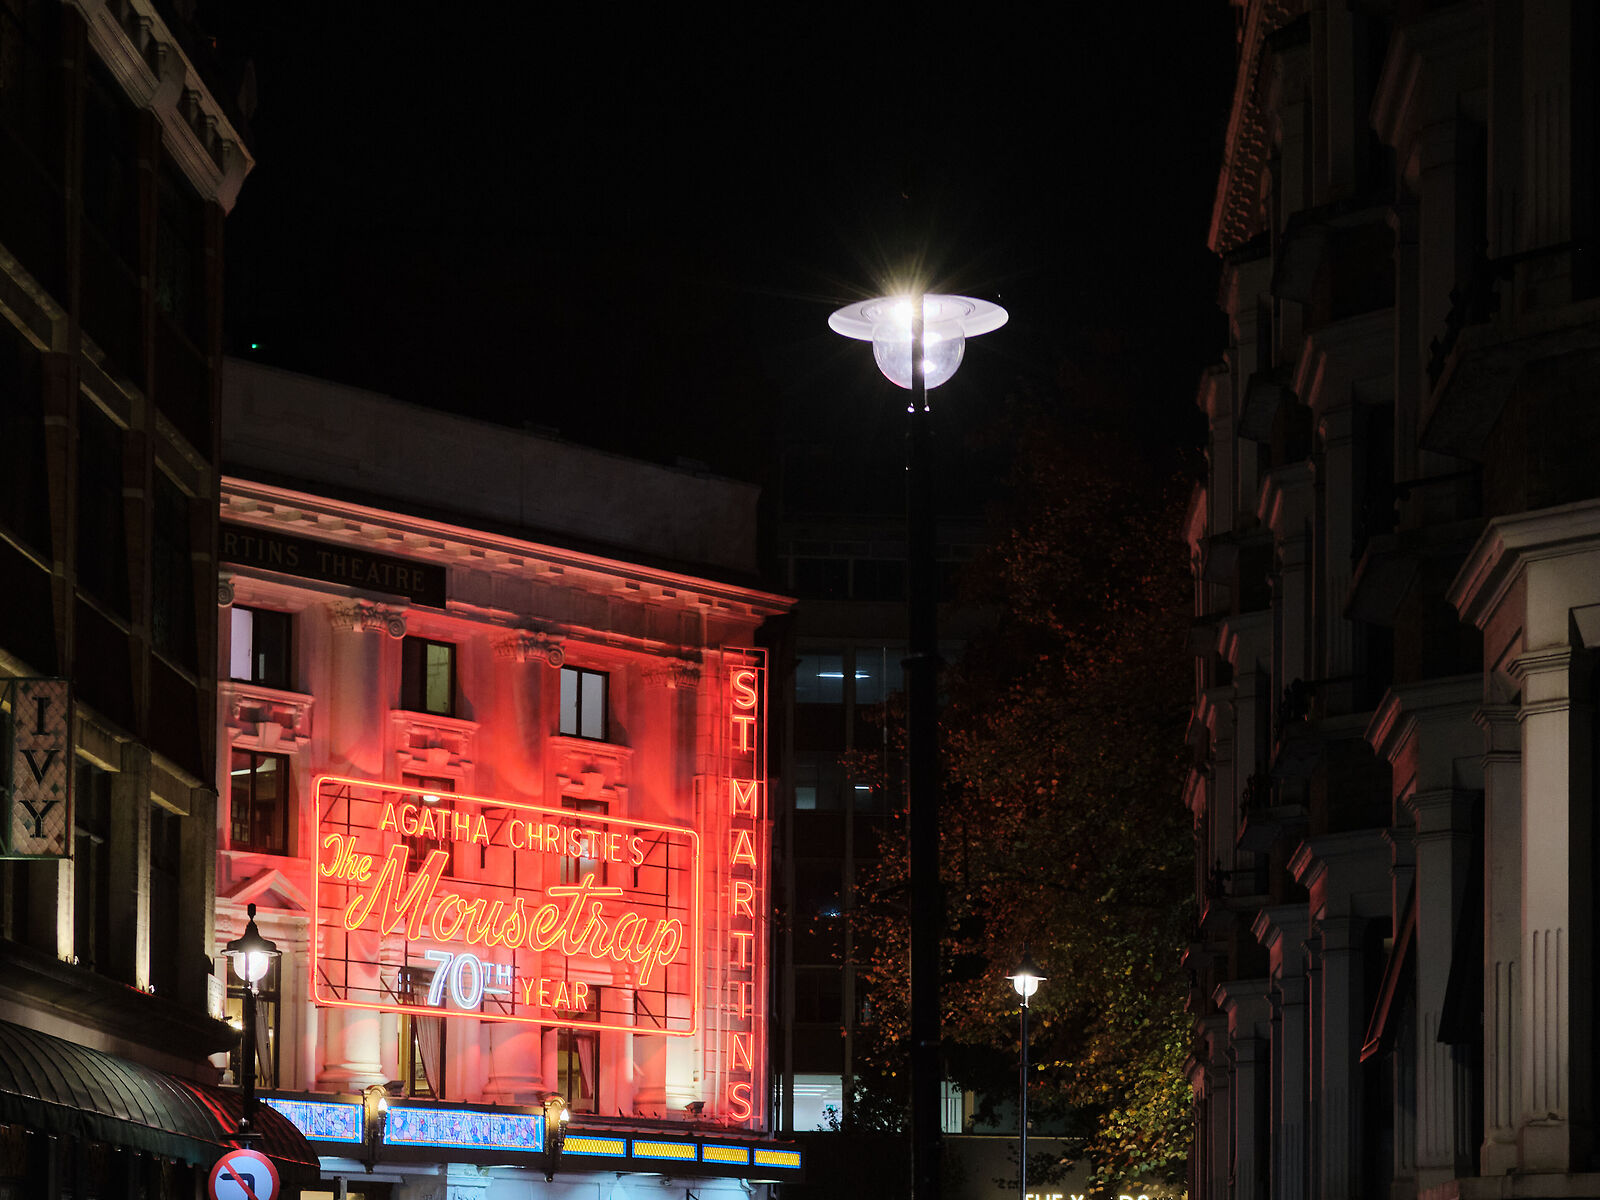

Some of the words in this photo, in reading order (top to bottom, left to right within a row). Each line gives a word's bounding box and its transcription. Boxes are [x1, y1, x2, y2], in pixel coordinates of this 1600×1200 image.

[223, 531, 299, 567] RTINS
[317, 551, 425, 592] THEATRE
[732, 671, 757, 754] ST
[18, 696, 61, 838] IVY
[321, 833, 373, 882] The
[381, 802, 490, 846] AGATHA
[509, 819, 644, 866] CHRISTIE'S
[344, 843, 683, 986] Mousetrap
[731, 779, 757, 1122] MARTINS
[521, 977, 590, 1011] YEAR
